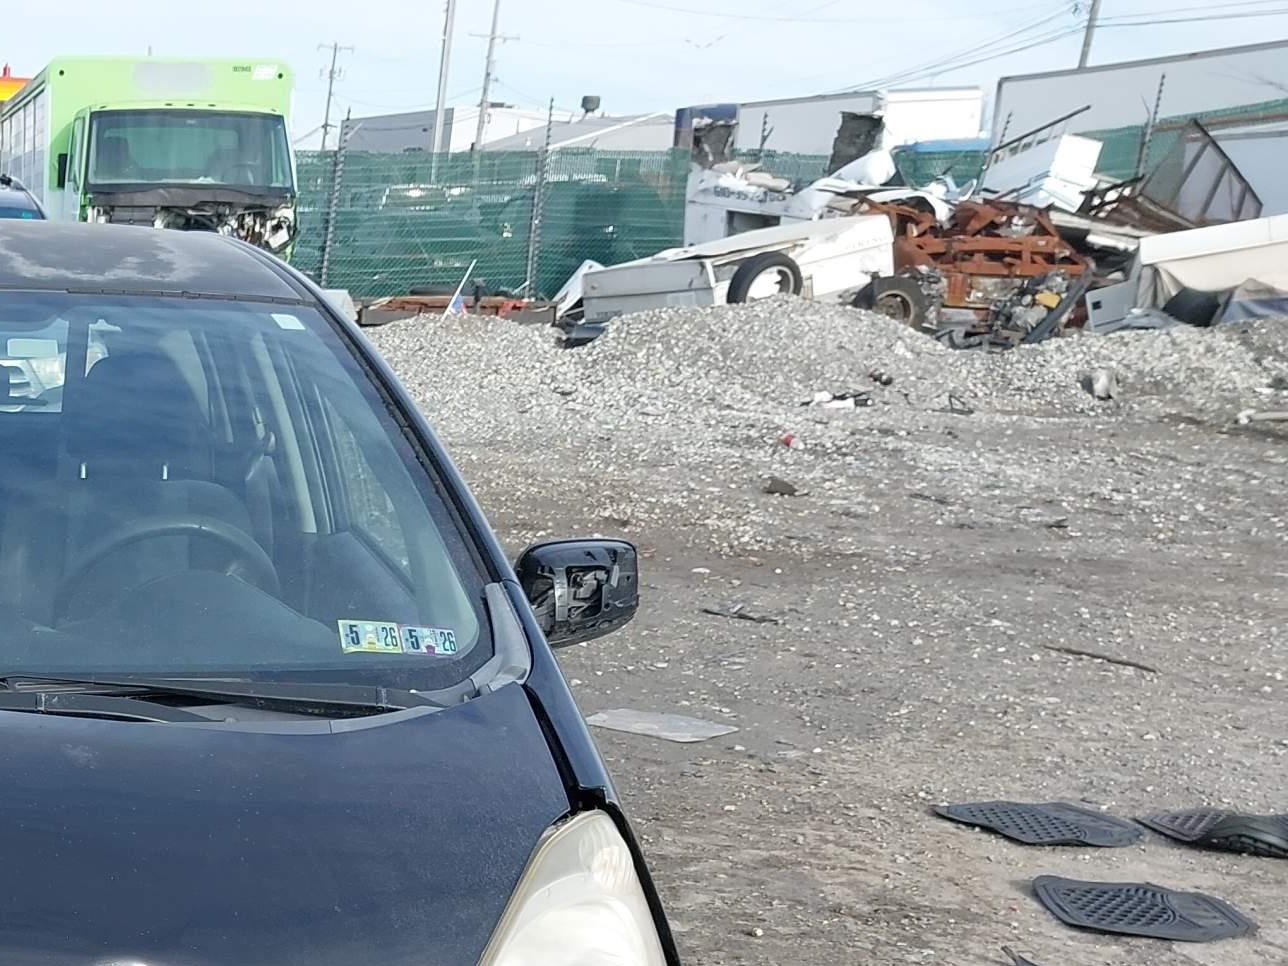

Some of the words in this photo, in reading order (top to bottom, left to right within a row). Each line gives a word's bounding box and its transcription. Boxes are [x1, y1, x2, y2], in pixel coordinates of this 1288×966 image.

[348, 624, 361, 646] 5
[381, 626, 399, 648] 26
[407, 628, 420, 650] 5
[439, 631, 457, 652] 26
